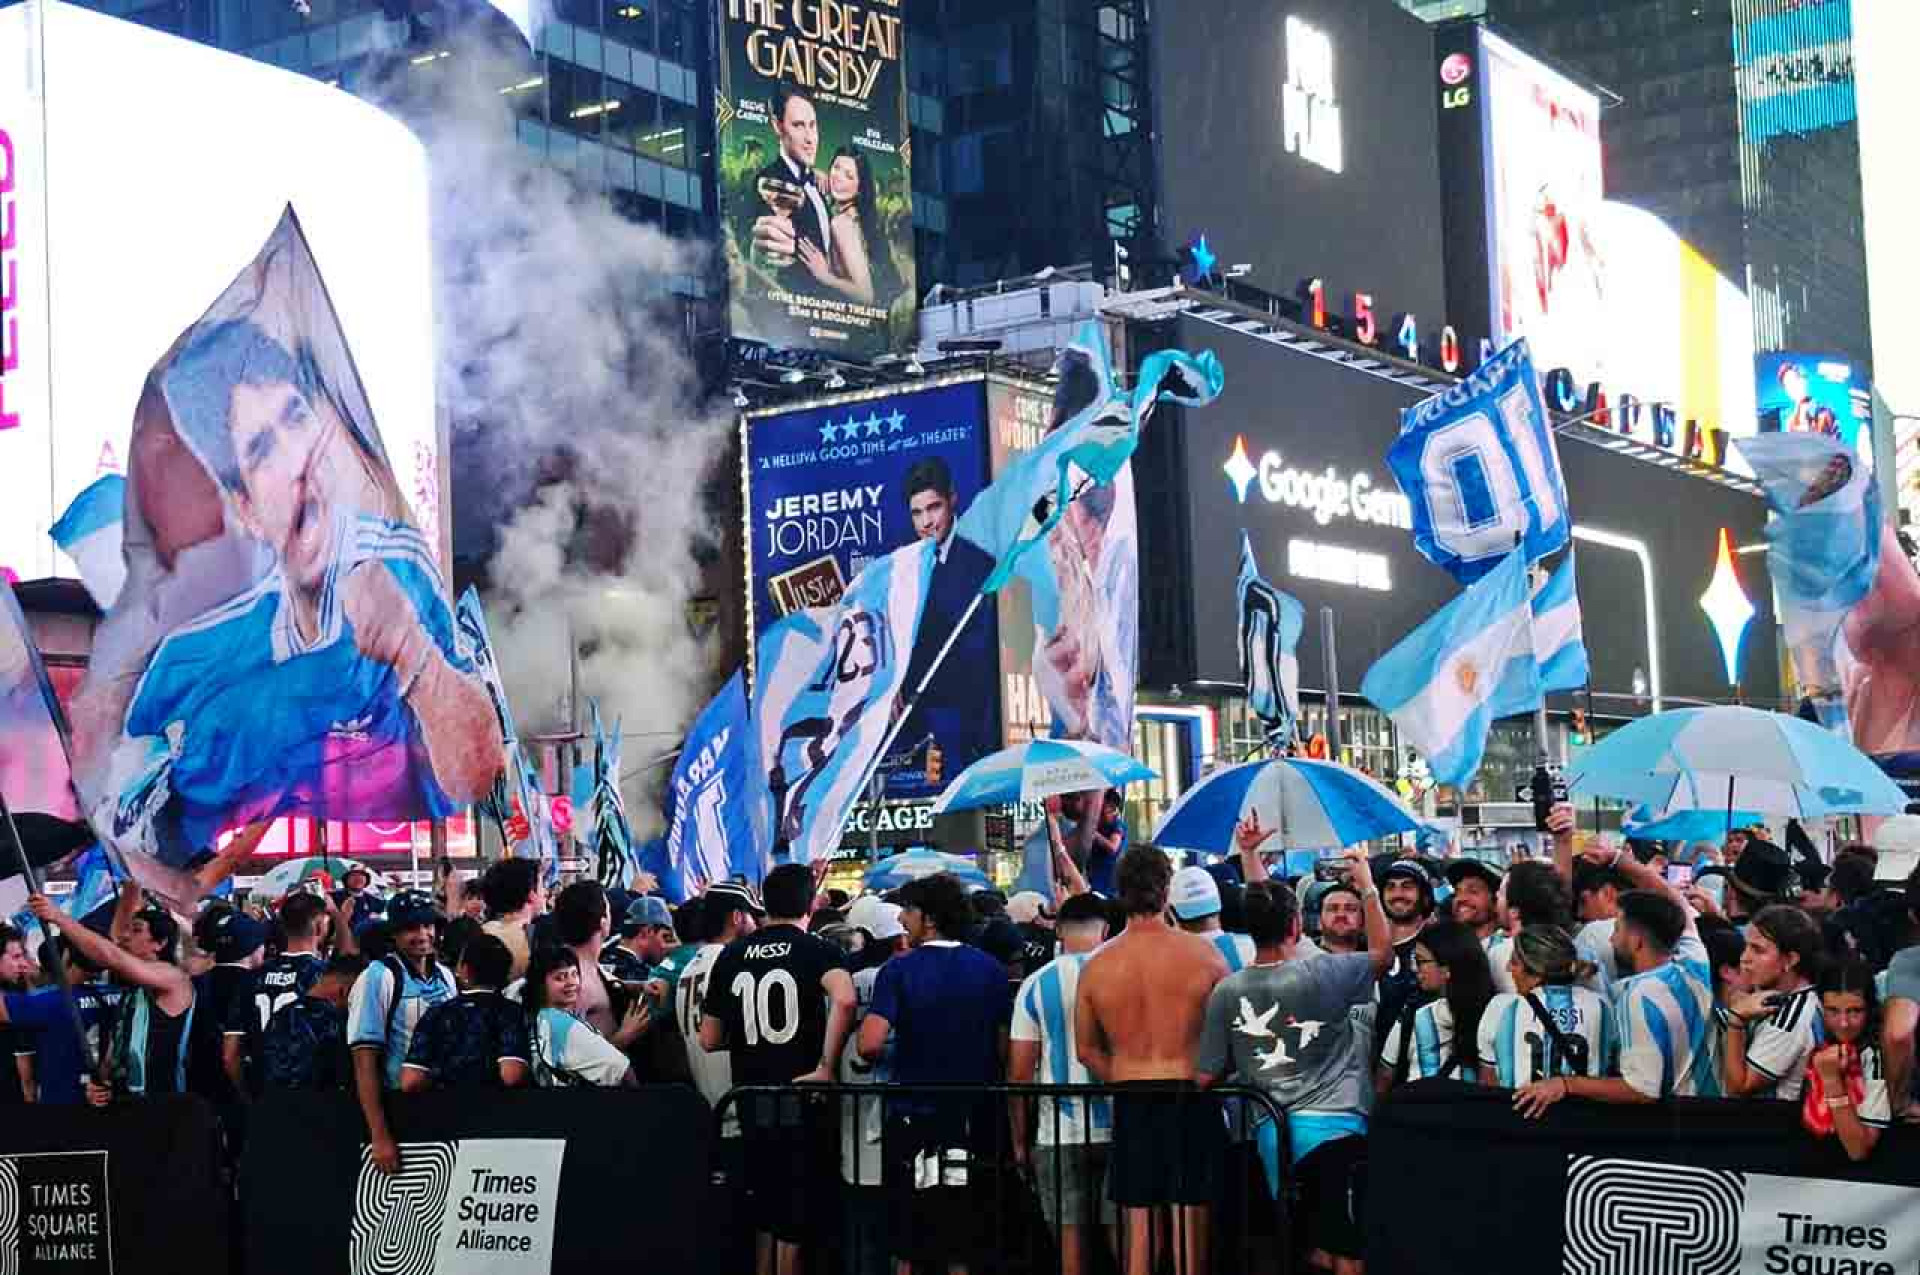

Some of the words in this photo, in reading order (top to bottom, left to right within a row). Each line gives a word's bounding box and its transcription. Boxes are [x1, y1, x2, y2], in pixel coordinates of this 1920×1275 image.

[792, 0, 900, 60] GREAT
[746, 29, 883, 100] GATSBY
[1443, 87, 1470, 109] LG
[772, 450, 817, 468] HELLUVA
[819, 444, 859, 461] GOOD
[861, 440, 886, 456] TIME
[1258, 448, 1349, 525] Google
[765, 484, 886, 519] JEREMY
[766, 509, 884, 558] JORDAN
[743, 943, 793, 960] MESSI
[731, 968, 799, 1045] 10
[1533, 1008, 1584, 1027] ESSI
[30, 1183, 92, 1207] TIMES
[471, 1168, 538, 1195] Times
[28, 1212, 99, 1239] SQUARE
[457, 1196, 540, 1227] Square
[456, 1229, 532, 1252] Alliance
[1777, 1211, 1888, 1251] Times
[35, 1242, 97, 1261] ALLIANCE
[1765, 1244, 1896, 1275] Square
